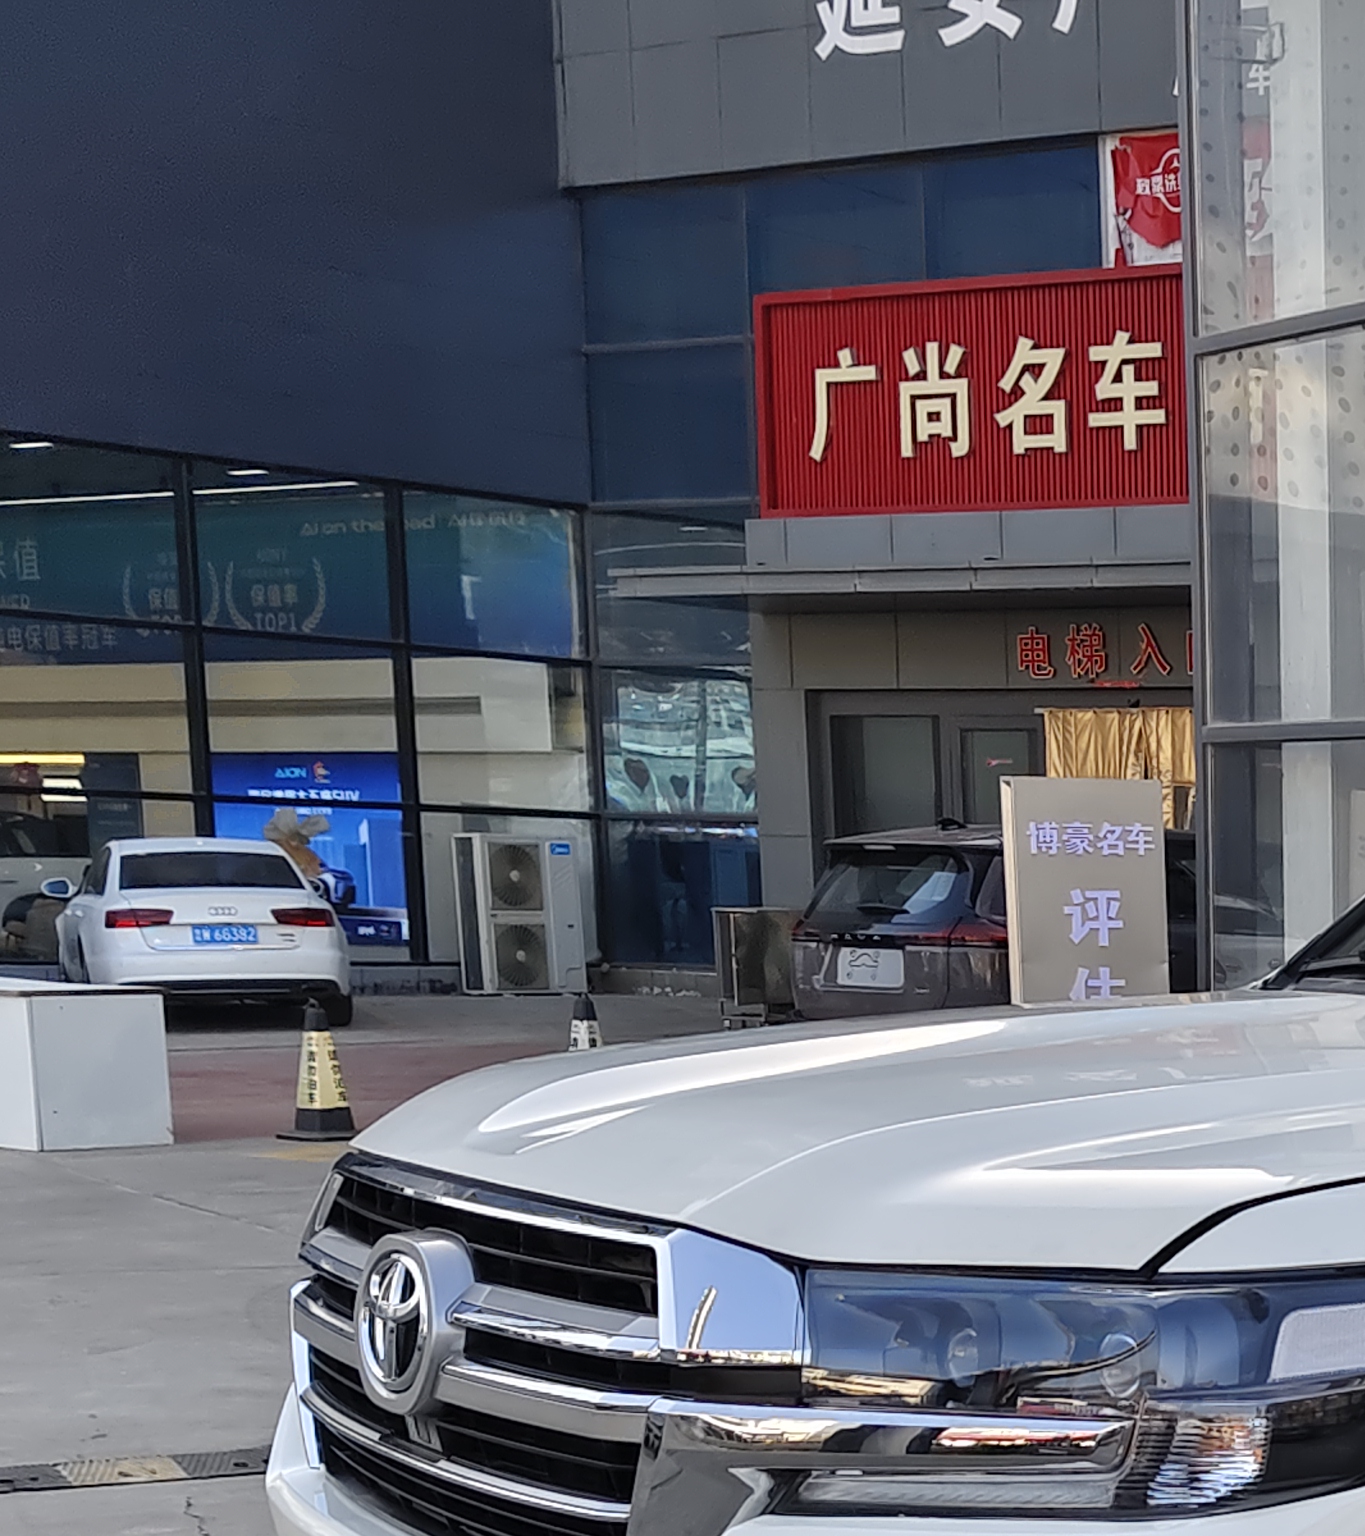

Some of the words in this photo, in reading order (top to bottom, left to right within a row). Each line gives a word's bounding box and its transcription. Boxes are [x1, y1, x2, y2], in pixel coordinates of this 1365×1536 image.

[808, 329, 1169, 463] 广尚名车
[1017, 622, 1194, 680] 电梯入
[1026, 821, 1156, 856] 博豪名车
